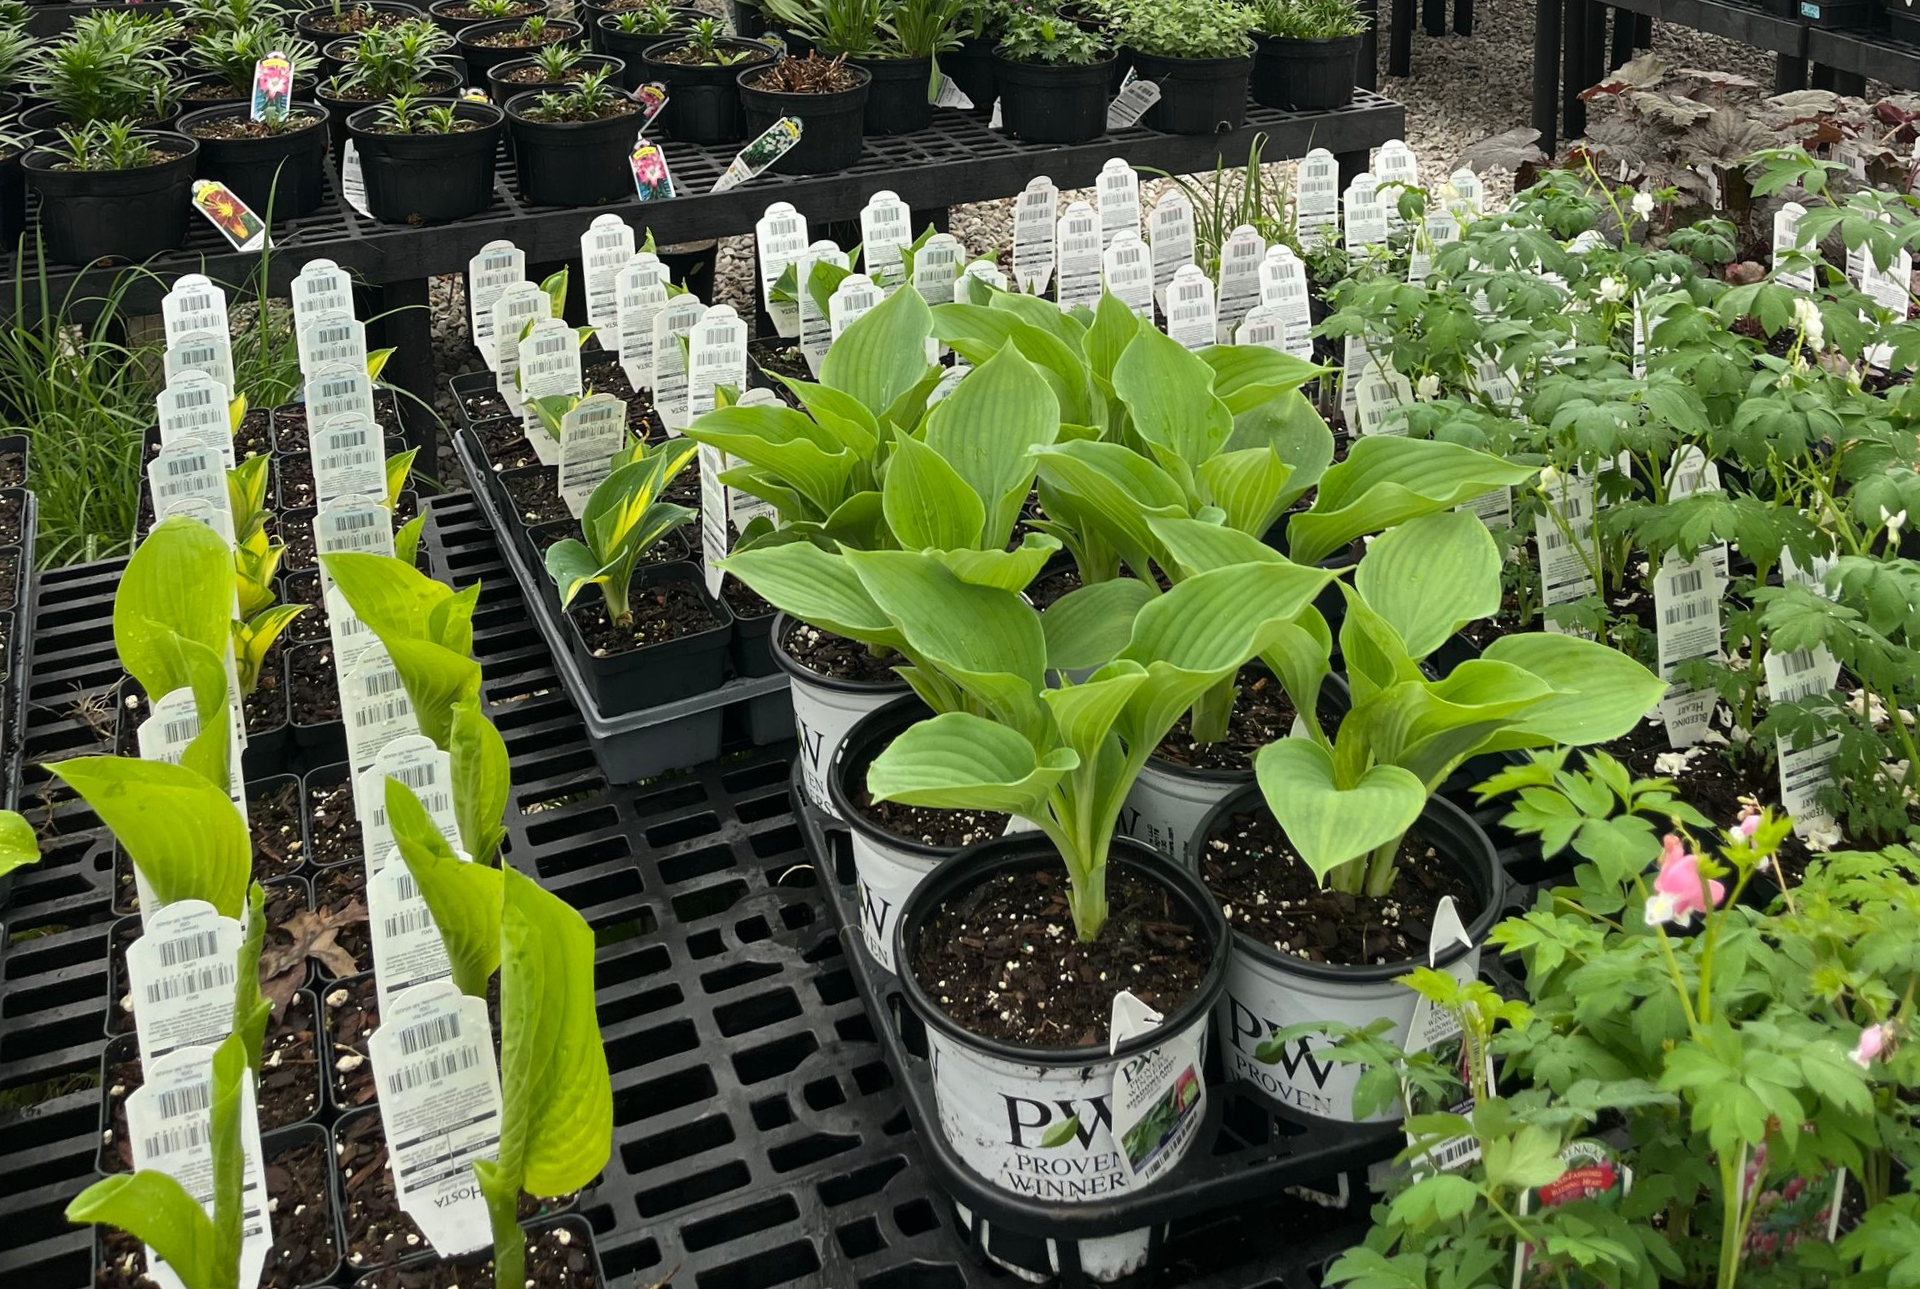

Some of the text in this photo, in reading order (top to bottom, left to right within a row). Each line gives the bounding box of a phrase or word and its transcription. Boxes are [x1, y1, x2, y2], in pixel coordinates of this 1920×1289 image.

[637, 361, 653, 370] OSTA
[671, 405, 688, 414] OSTA
[1678, 701, 1704, 715] HEART
[1671, 712, 1708, 729] BLEEDING
[799, 716, 825, 773] W
[1797, 806, 1824, 824] EEDING
[860, 877, 892, 941] W
[1236, 1053, 1332, 1114] PROVEN
[998, 1092, 1113, 1151] PW
[1007, 1171, 1126, 1198] WINNER
[434, 1186, 484, 1208] HOSTA
